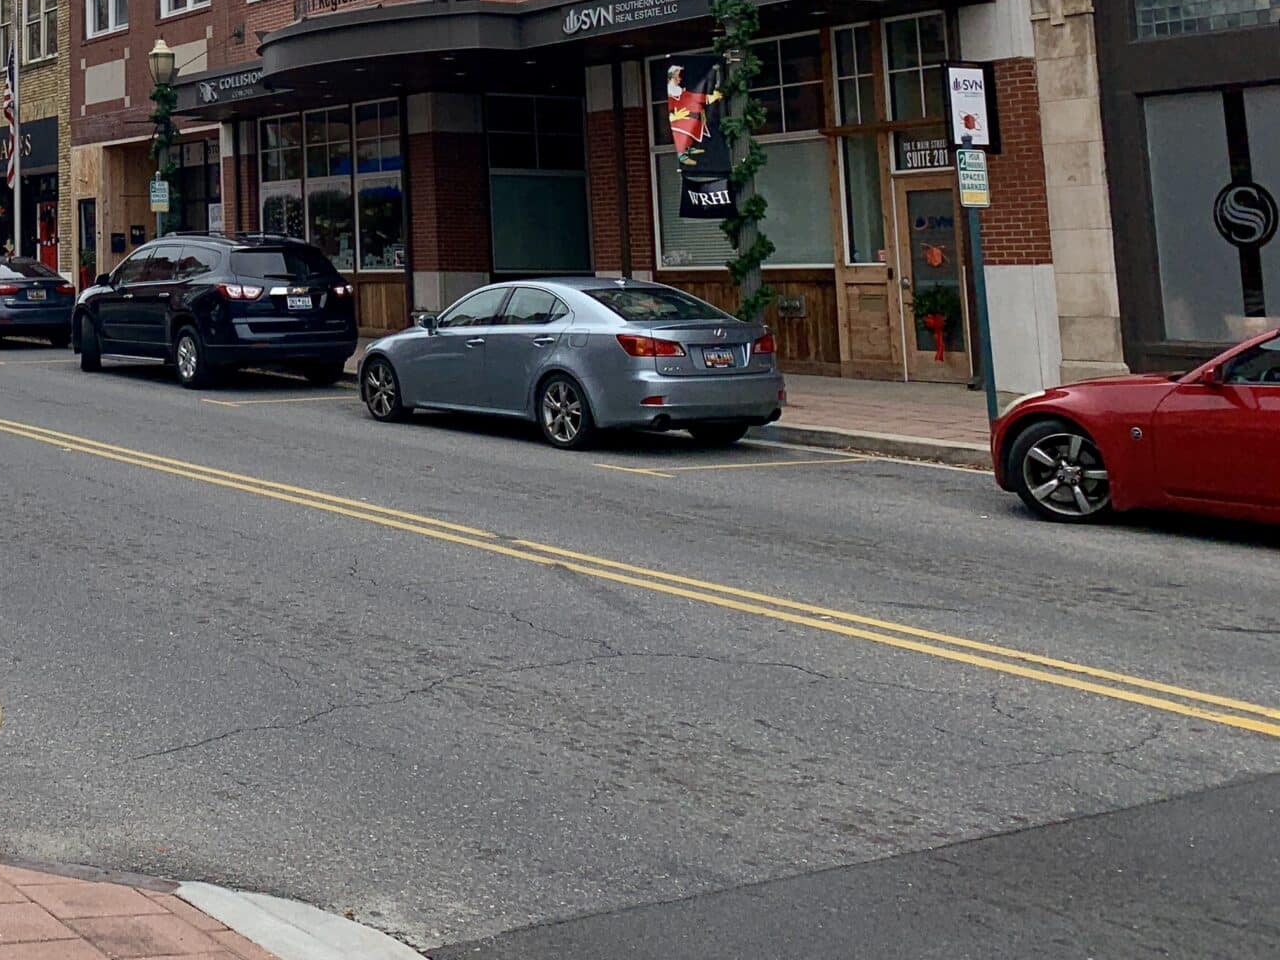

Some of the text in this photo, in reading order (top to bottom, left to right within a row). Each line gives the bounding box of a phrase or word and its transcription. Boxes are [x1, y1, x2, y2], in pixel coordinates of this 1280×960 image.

[581, 5, 613, 30] SVN
[615, 14, 635, 23] REAL
[663, 4, 678, 15] LLC
[219, 71, 264, 90] COLLISION
[962, 79, 983, 91] SVN
[906, 149, 949, 168] SUITE 201
[959, 153, 966, 168] 2
[961, 172, 985, 182] SPACES
[687, 190, 731, 206] WRHI
